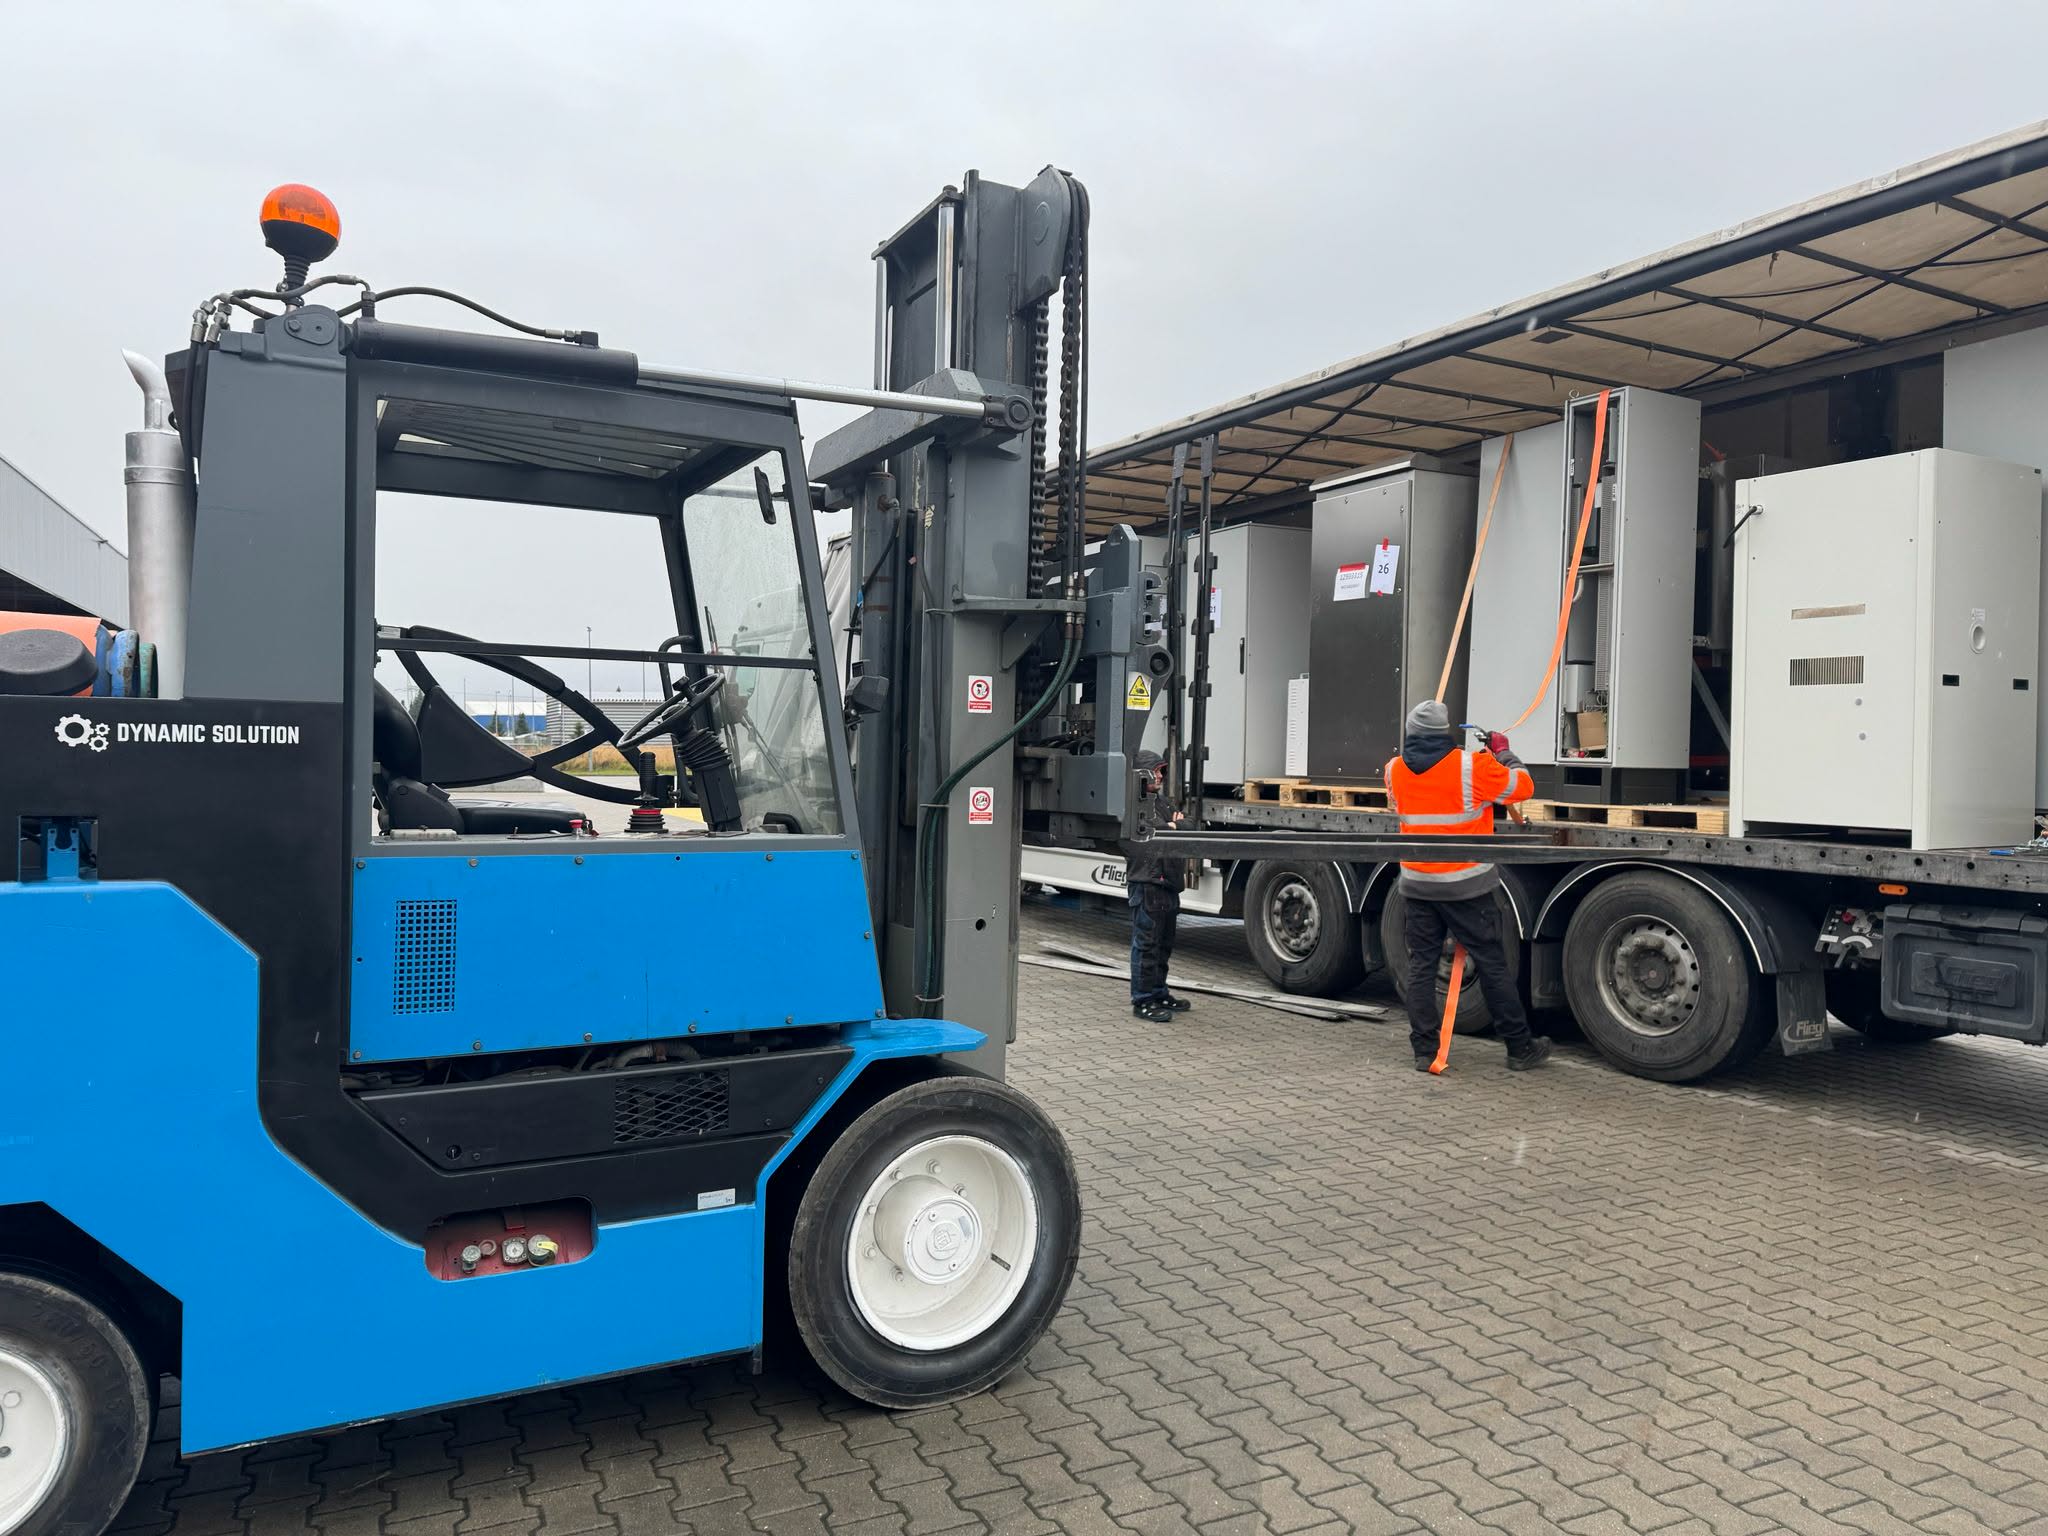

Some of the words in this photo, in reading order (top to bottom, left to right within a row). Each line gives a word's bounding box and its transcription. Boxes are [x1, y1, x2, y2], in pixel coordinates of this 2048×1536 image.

[1378, 562, 1390, 574] 26
[117, 722, 206, 743] DYNAMIC
[212, 724, 300, 745] SOLUTION
